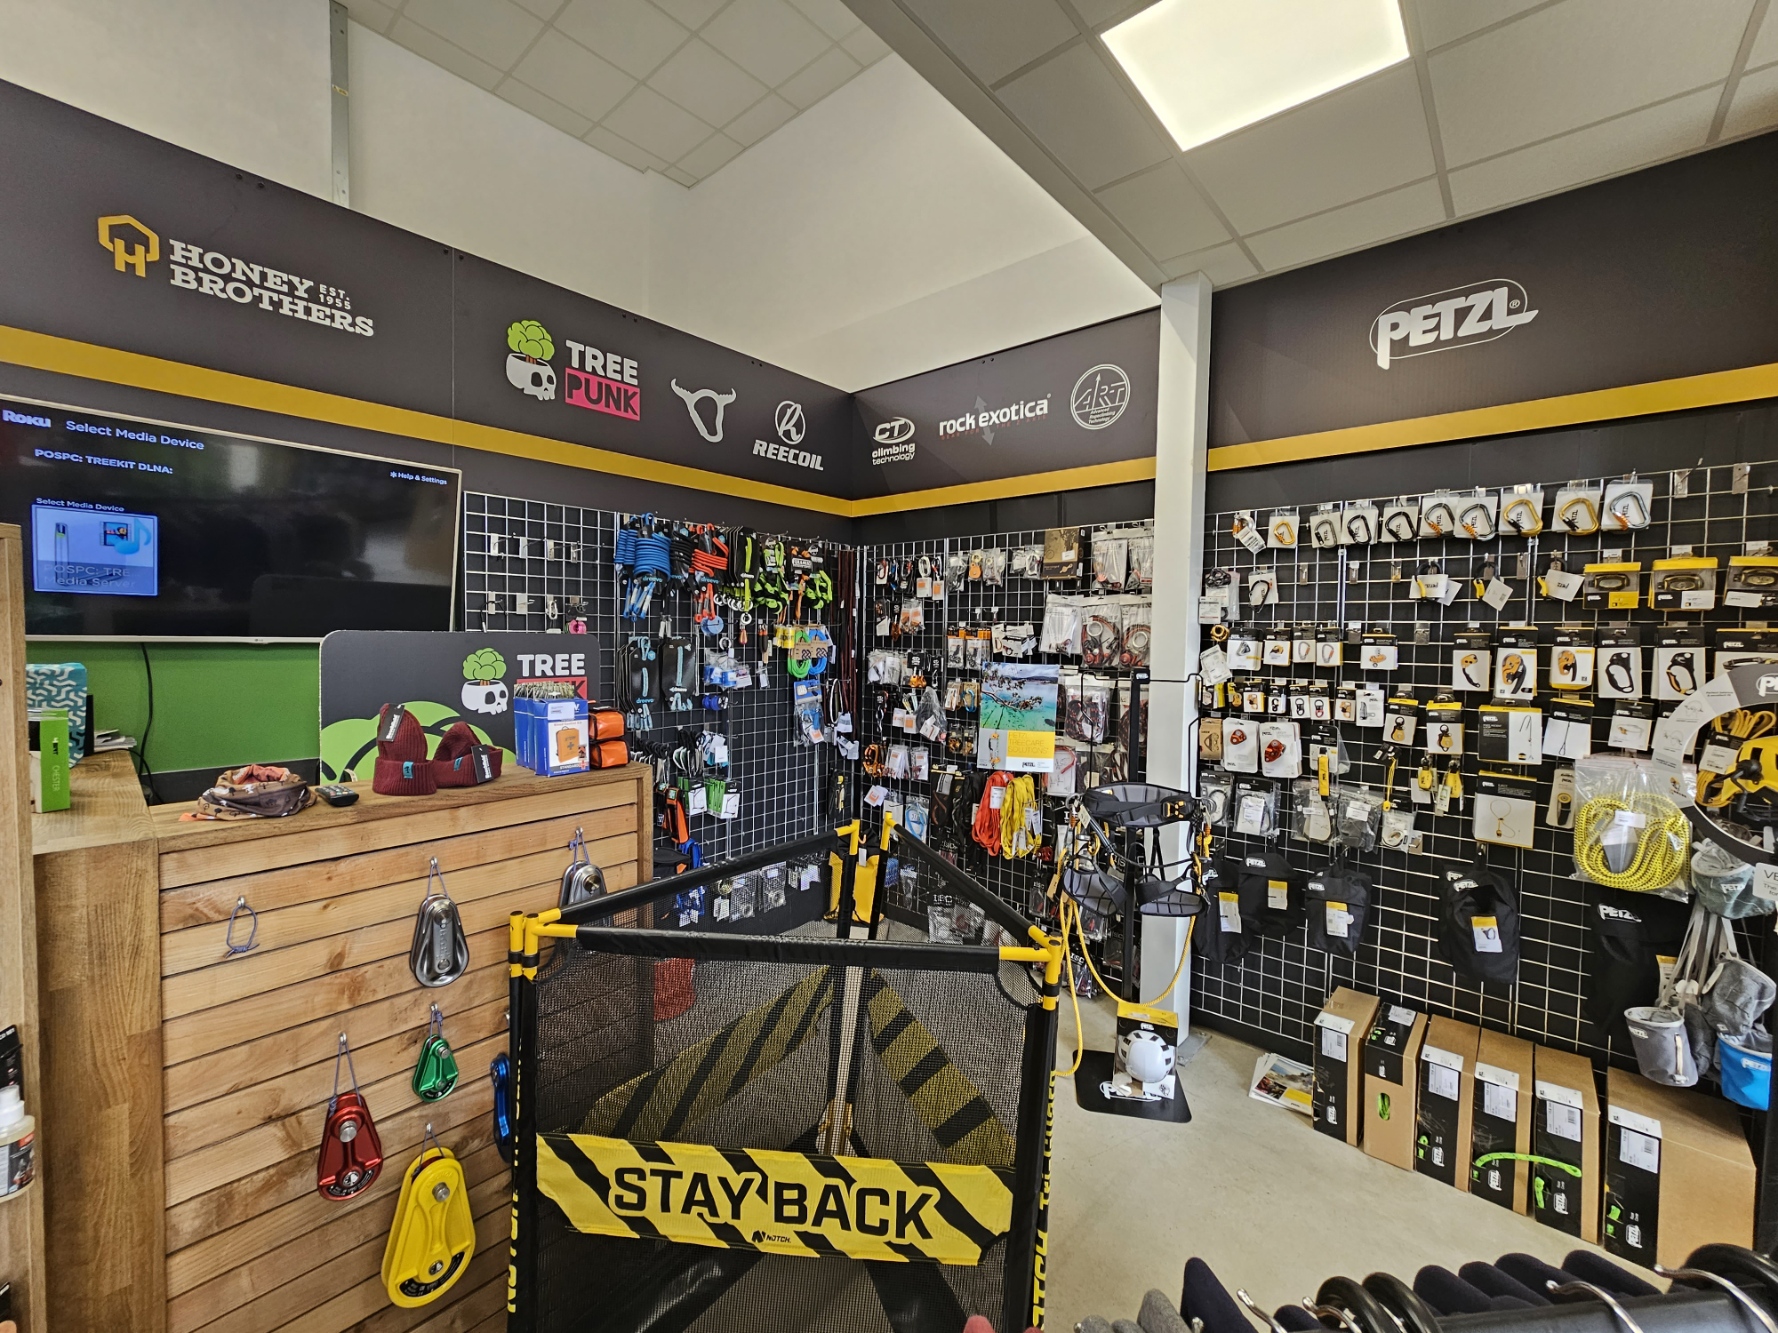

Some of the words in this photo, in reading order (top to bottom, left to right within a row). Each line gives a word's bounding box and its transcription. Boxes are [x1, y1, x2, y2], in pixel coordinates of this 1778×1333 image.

[169, 238, 314, 299] HONEY
[170, 264, 374, 337] BROTHERS
[319, 283, 350, 299] EST.
[319, 293, 352, 310] 1955
[1377, 287, 1539, 370] PETZL
[565, 340, 639, 385] TREE
[566, 370, 640, 418] PUNK
[874, 420, 904, 441] CT
[939, 412, 975, 437] rock
[979, 399, 1049, 426] exotica
[66, 420, 112, 437] Select
[116, 428, 157, 444] Media
[160, 435, 205, 450] Device
[34, 448, 83, 463] POSPC:
[85, 455, 136, 470] TREEKIT
[138, 463, 173, 475] DLNA:
[752, 439, 824, 471] REECOIL
[872, 442, 916, 459] climbing
[873, 451, 915, 466] technology
[398, 472, 414, 481] Help
[421, 476, 448, 485] Settings
[36, 497, 65, 507] Select
[66, 501, 94, 510] Media
[95, 504, 125, 513] Device
[44, 575, 88, 587] Media
[91, 577, 136, 589] Server
[516, 653, 586, 677] TREE
[52, 765, 61, 792] CHESTER
[614, 1166, 756, 1222] STAY
[773, 1181, 935, 1242] BACK
[766, 1234, 790, 1245] NOTCH
